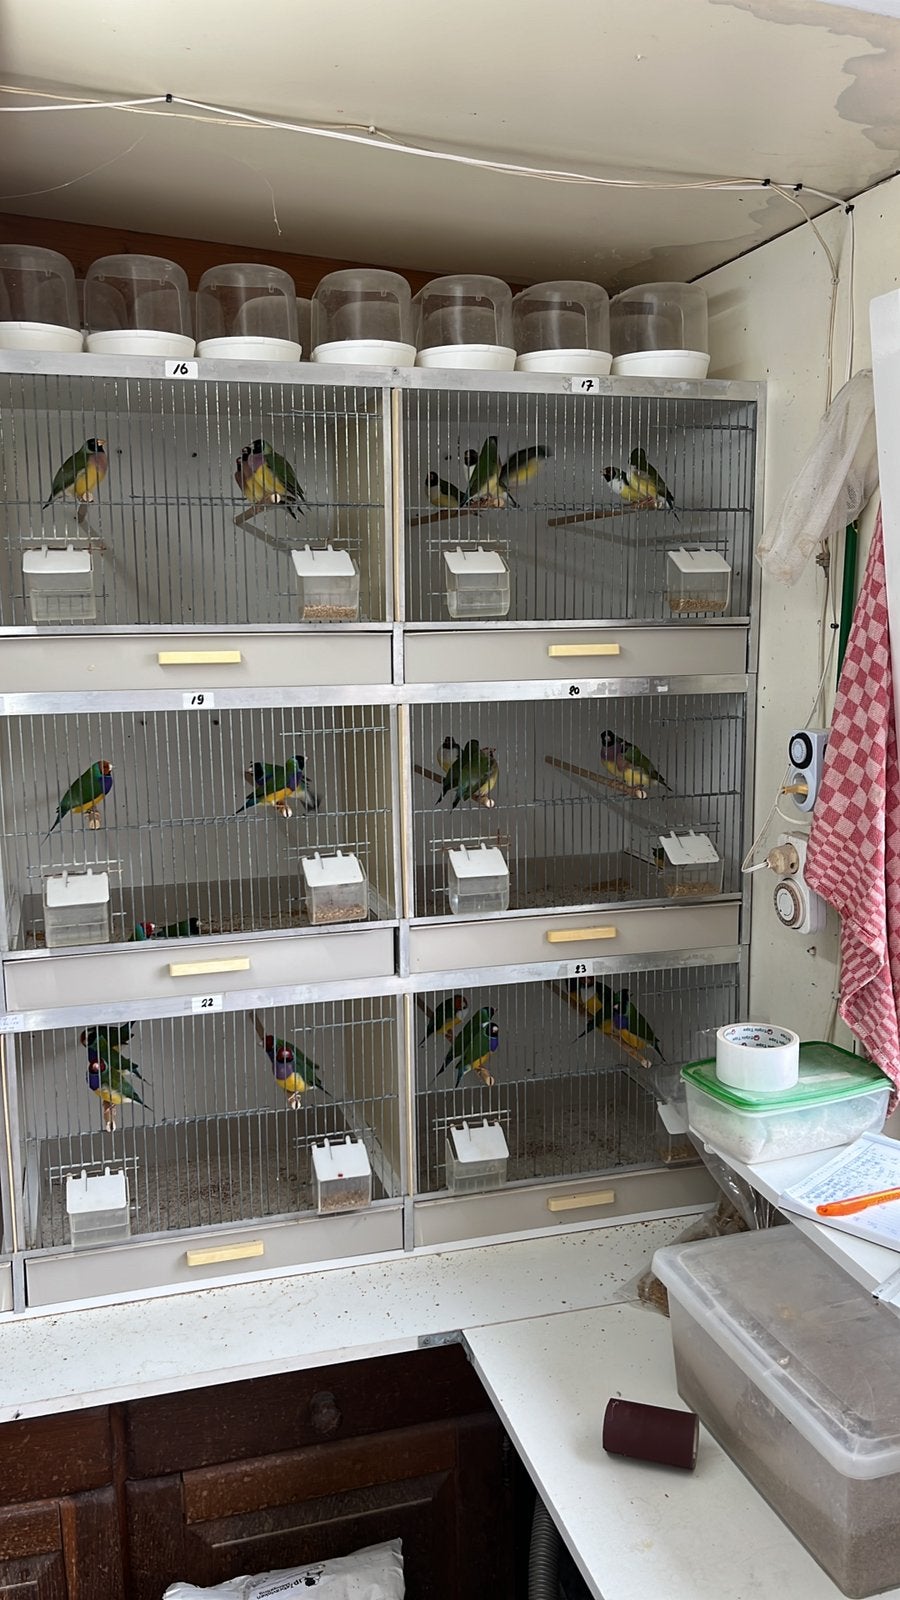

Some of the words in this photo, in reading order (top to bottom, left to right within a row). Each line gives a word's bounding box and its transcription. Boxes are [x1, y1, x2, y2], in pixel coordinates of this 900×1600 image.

[173, 363, 189, 375] 16
[581, 379, 594, 392] 17
[191, 694, 205, 705] 19
[574, 964, 587, 974] 23
[201, 998, 214, 1008] 22
